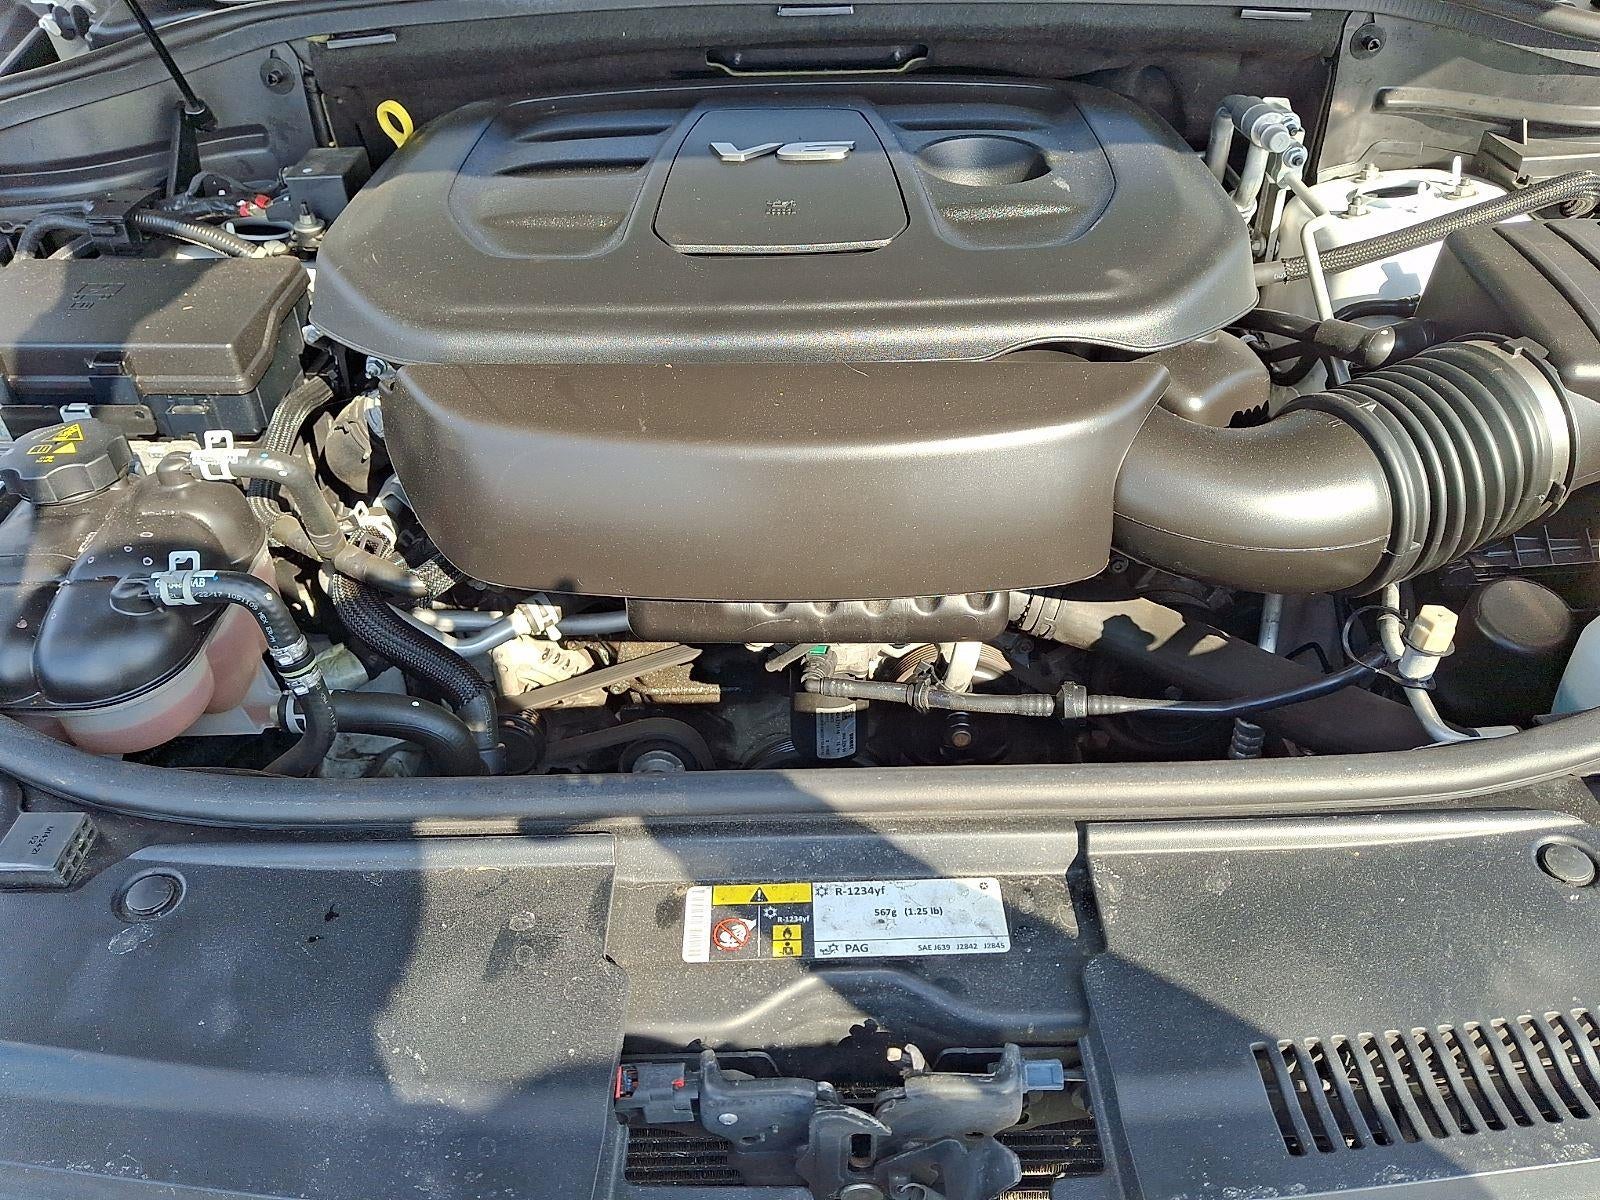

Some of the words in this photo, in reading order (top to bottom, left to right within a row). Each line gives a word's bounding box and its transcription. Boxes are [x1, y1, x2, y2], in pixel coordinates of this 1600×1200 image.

[709, 140, 856, 162] V6
[835, 886, 886, 896] R-1234yf
[874, 908, 897, 917] 567g
[904, 907, 928, 917] (1.25
[930, 906, 943, 916] lb)
[777, 914, 810, 923] R-1234yf
[845, 943, 869, 953] PAG
